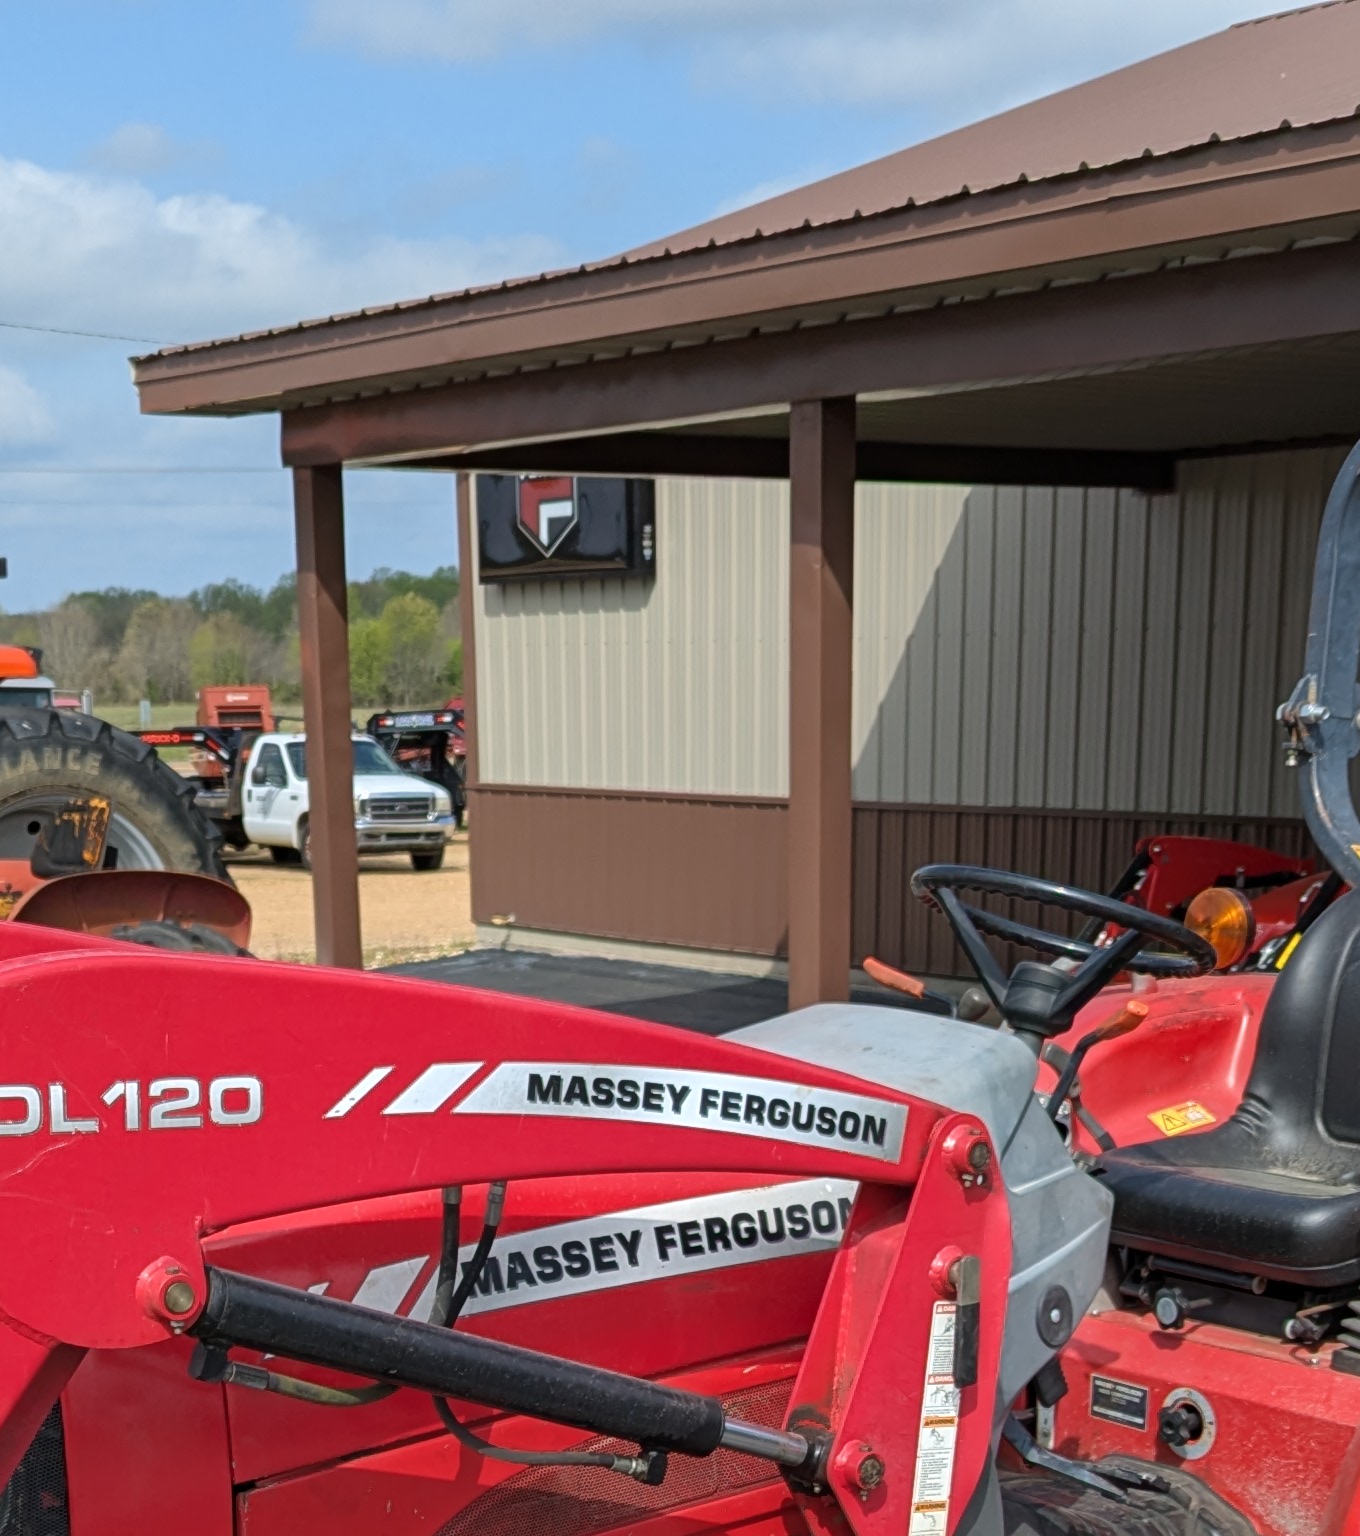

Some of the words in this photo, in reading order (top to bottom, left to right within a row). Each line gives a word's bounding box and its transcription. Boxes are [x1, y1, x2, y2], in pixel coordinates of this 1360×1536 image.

[527, 1073, 691, 1116] MASSEY
[698, 1089, 888, 1148] FERGUSON
[460, 1231, 642, 1300] MASSEY
